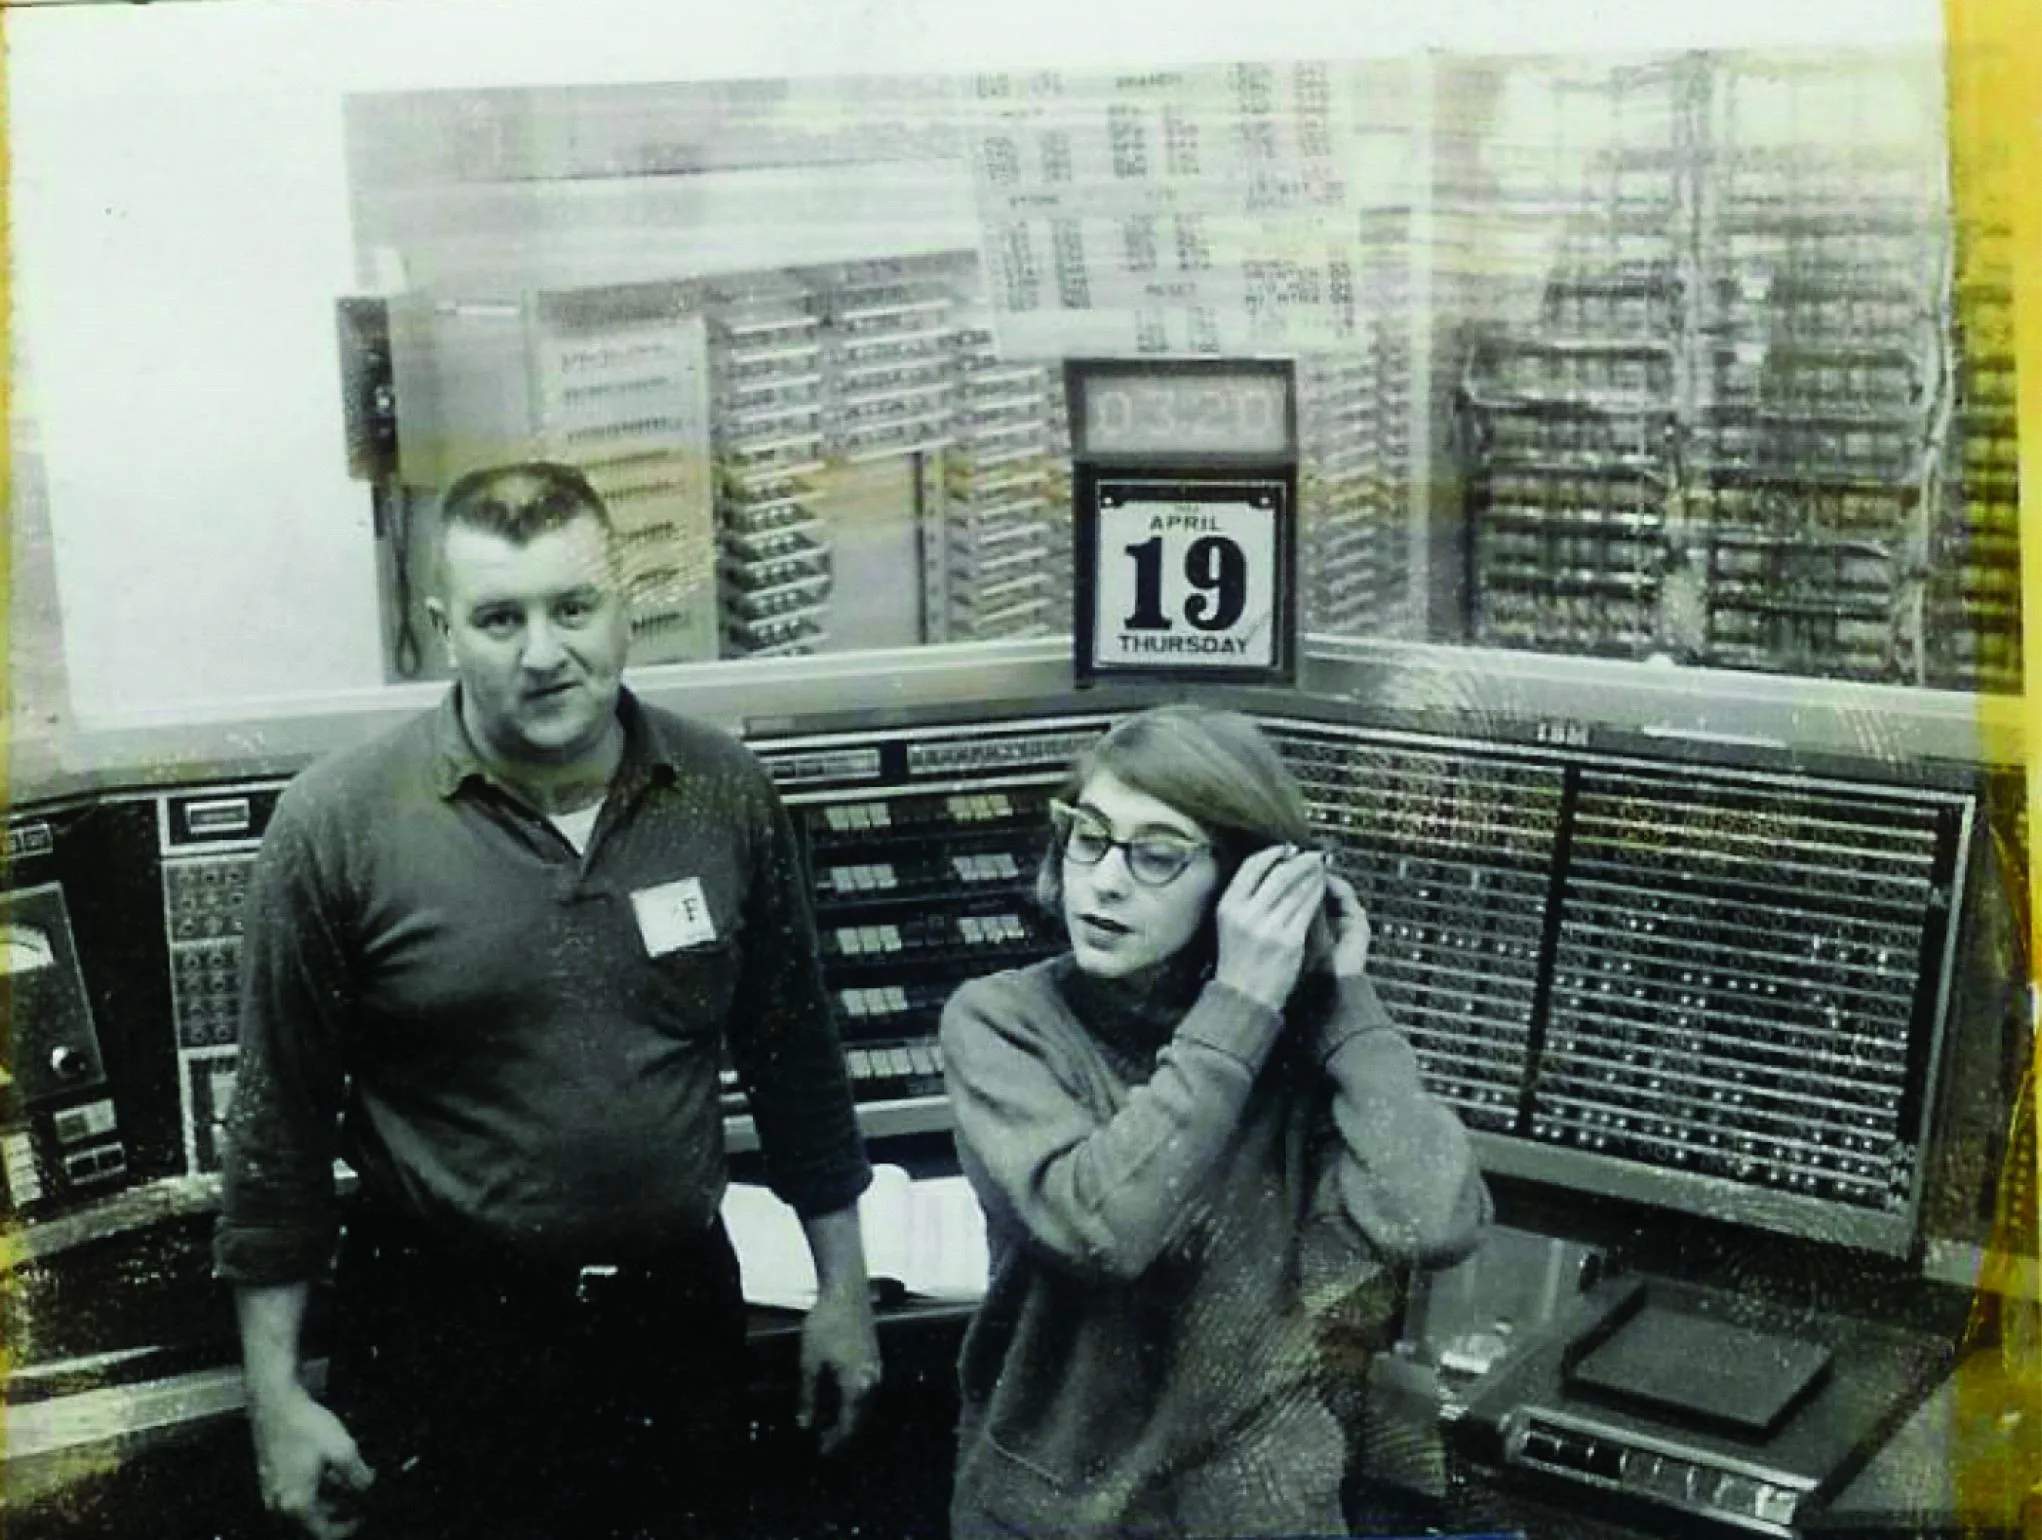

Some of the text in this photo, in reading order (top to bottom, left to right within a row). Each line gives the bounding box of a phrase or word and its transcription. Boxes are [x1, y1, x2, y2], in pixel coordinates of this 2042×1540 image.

[1149, 514, 1224, 531] APRIL
[1123, 535, 1248, 631] 19
[1117, 634, 1251, 655] THURSDAY
